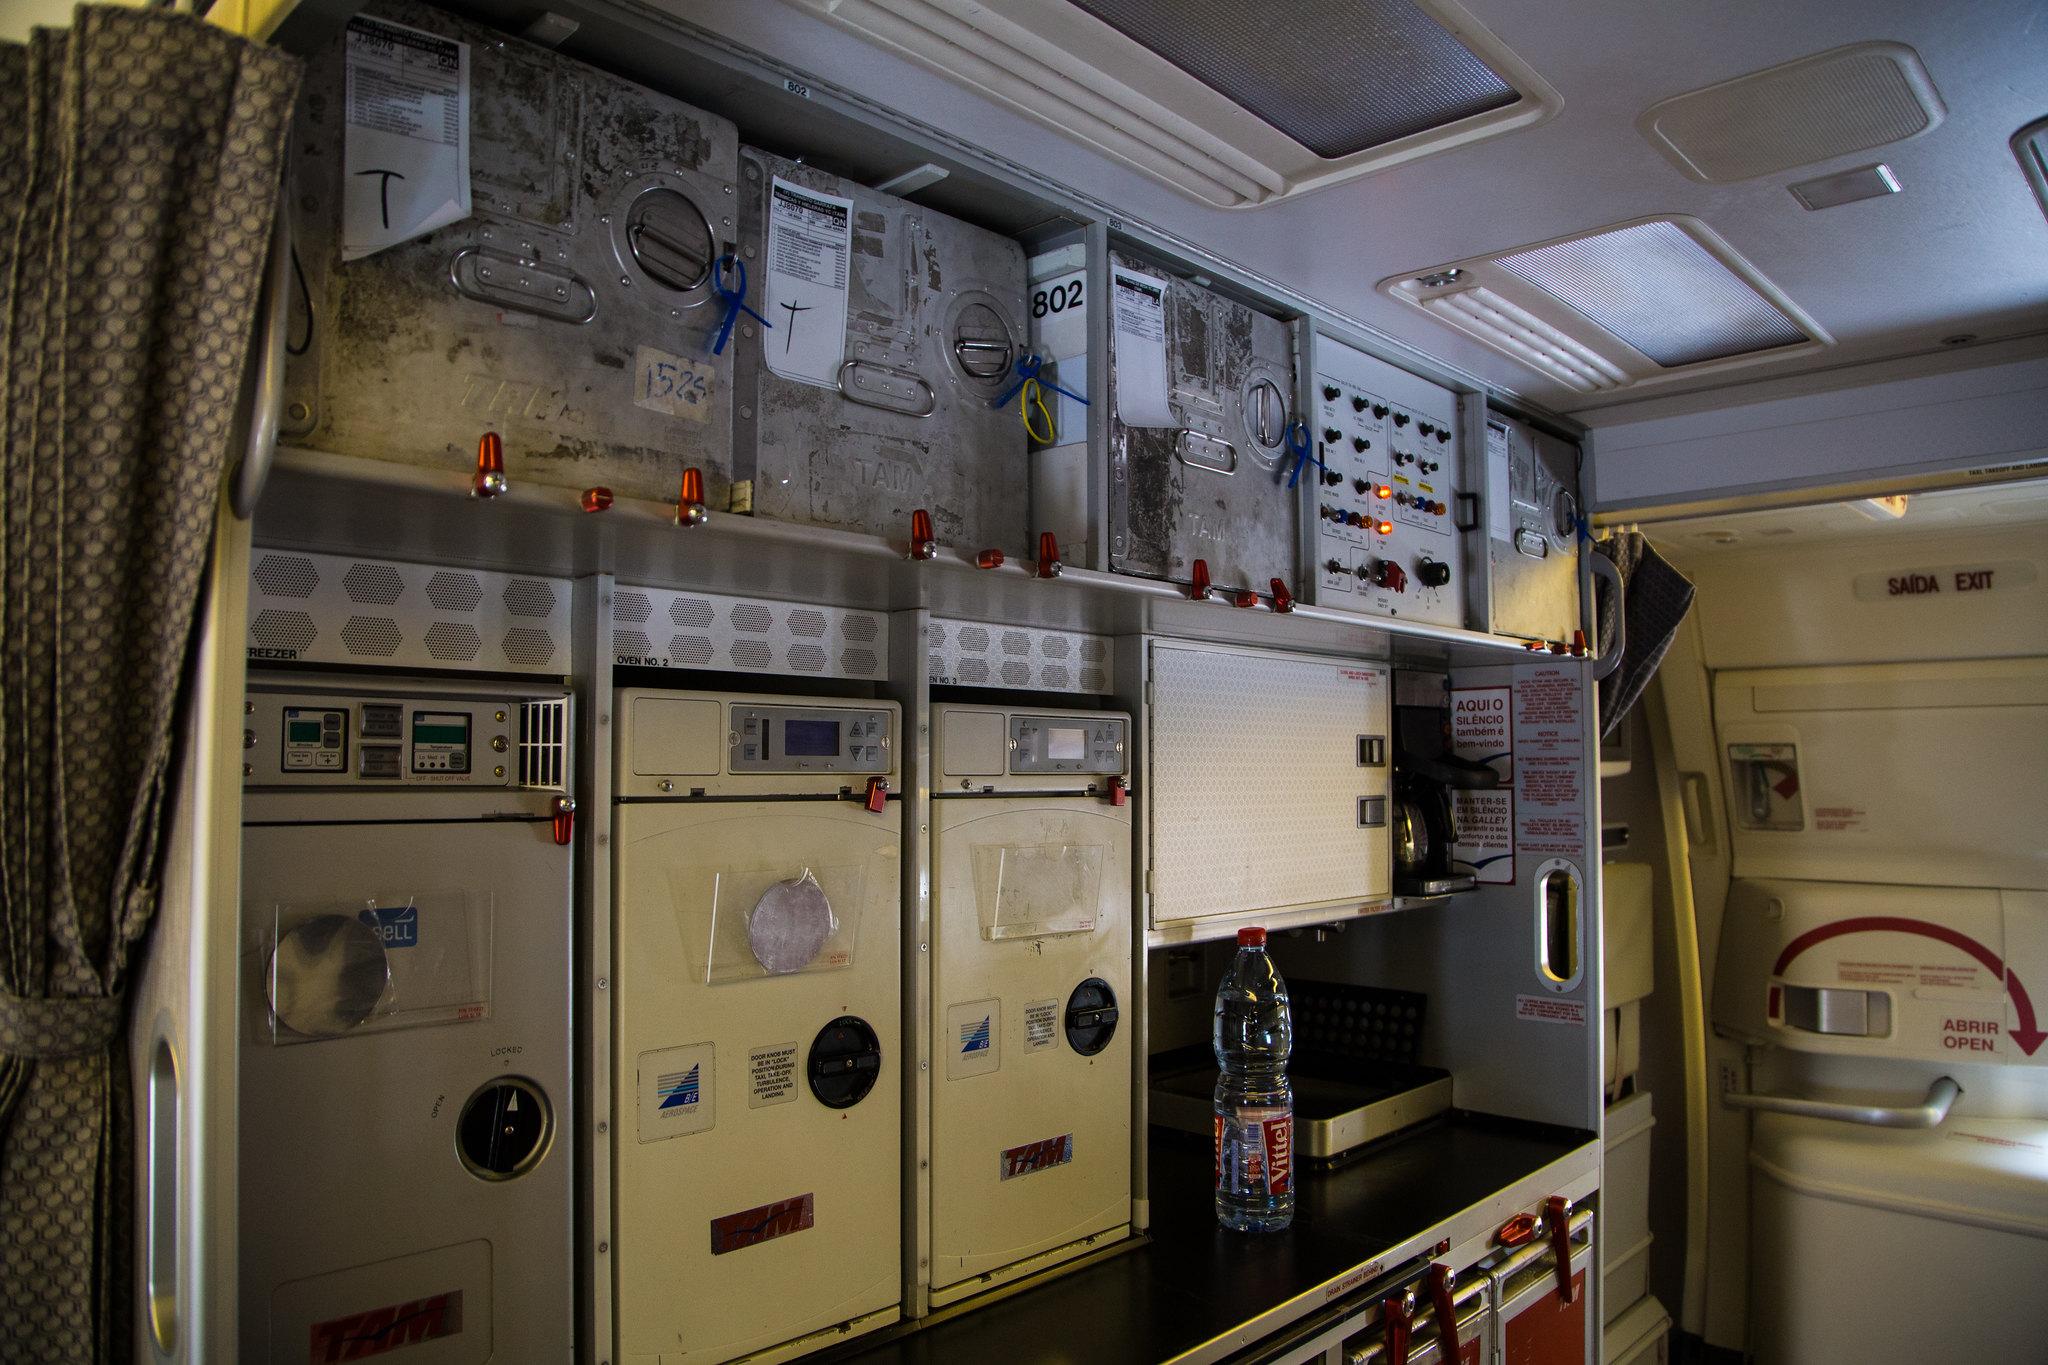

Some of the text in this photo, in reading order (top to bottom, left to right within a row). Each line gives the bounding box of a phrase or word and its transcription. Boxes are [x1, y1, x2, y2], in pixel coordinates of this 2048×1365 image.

[788, 81, 807, 97] 802
[354, 168, 405, 230] T
[778, 199, 804, 215] JJ8070
[1109, 218, 1122, 230] 803
[1031, 279, 1084, 319] 802
[1888, 570, 1994, 596] SAÍDA EXIT
[617, 655, 669, 667] OVEN NO. 2
[939, 676, 951, 685] NO.
[952, 677, 957, 685] 3
[1456, 698, 1503, 712] AQUI O
[1456, 713, 1504, 726] SILÊNCIO
[1456, 726, 1496, 737] também
[1456, 739, 1505, 748] bem-vindo
[1456, 797, 1507, 805] MANTER-SE
[1456, 806, 1468, 814] EM
[1457, 815, 1507, 824] NA GALLEY
[1463, 825, 1488, 833] garantir
[1943, 1018, 1999, 1035] ABRIR
[1943, 1036, 1995, 1052] OPEN
[490, 1046, 523, 1057] LOCKED
[751, 1053, 766, 1061] DOOR
[781, 1048, 796, 1056] MUST
[751, 1062, 795, 1074] POSITION DURING
[753, 1084, 782, 1094] OPERATION
[430, 1094, 446, 1118] OPEN
[660, 1104, 699, 1119] AEROSPACE
[1006, 1135, 1067, 1176] TAM
[1271, 1121, 1287, 1184] Vittel
